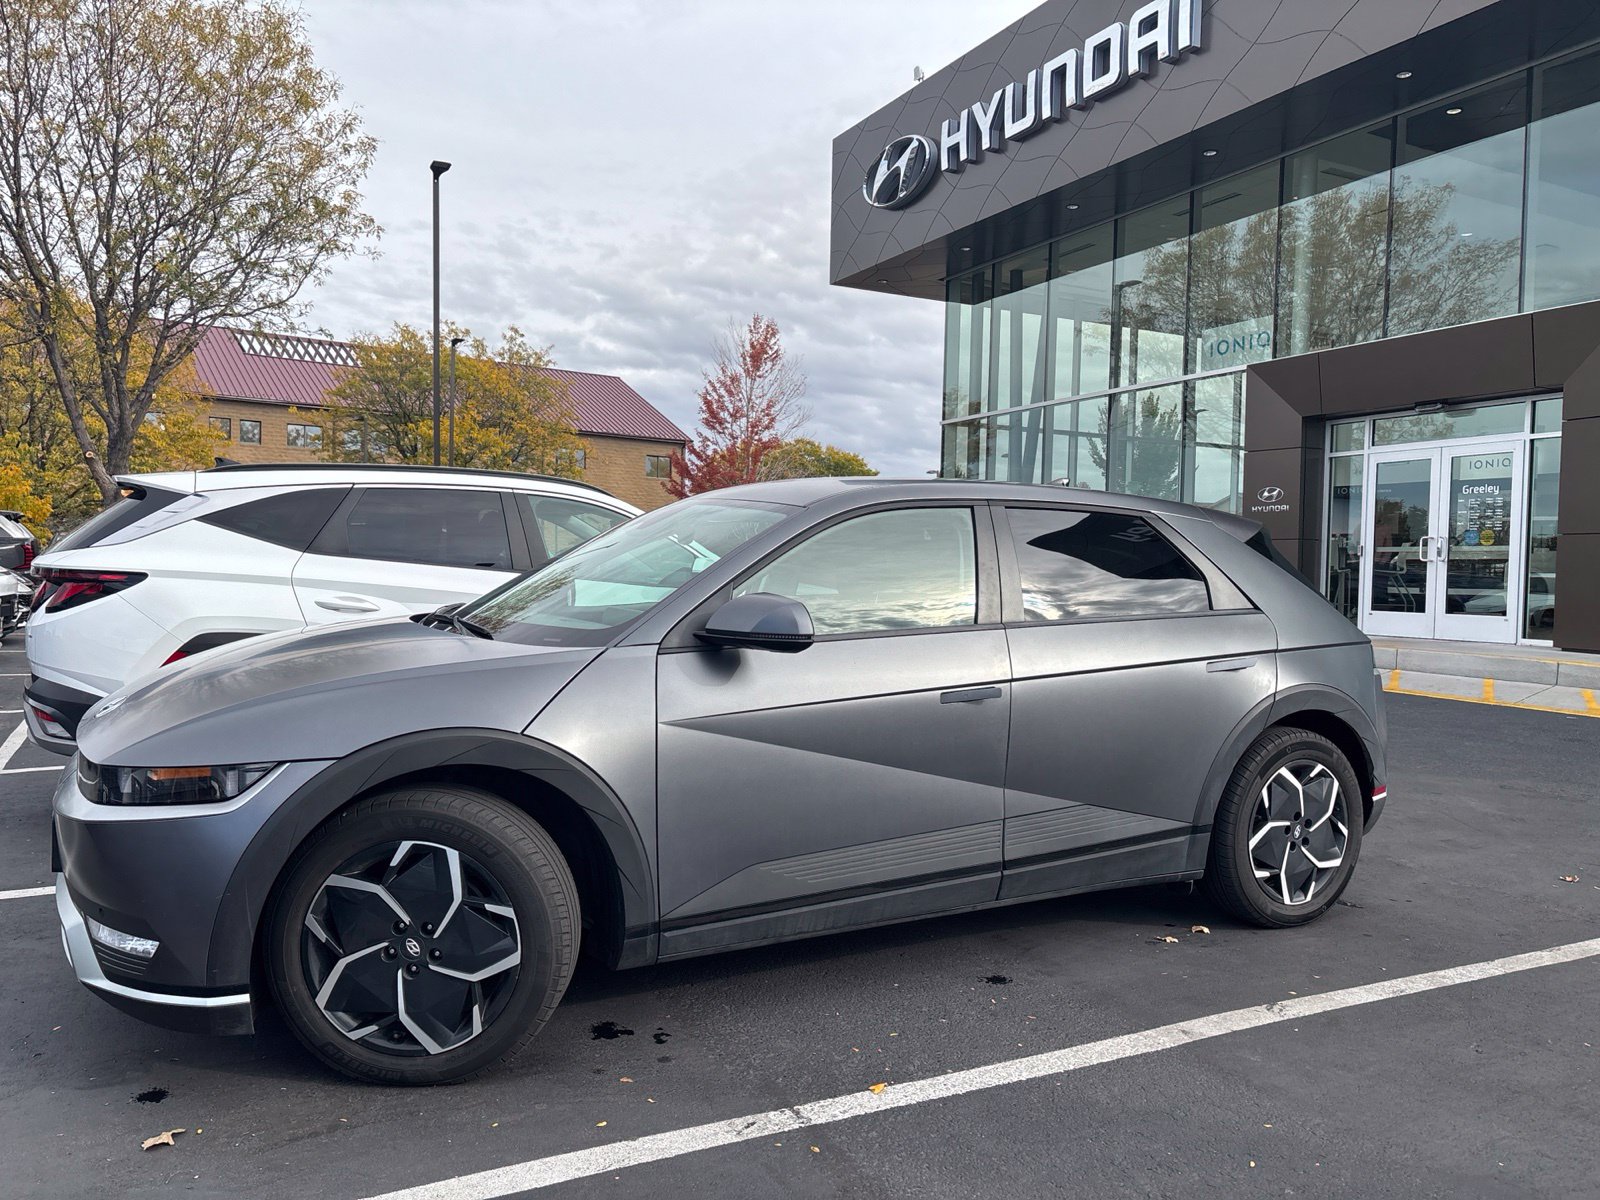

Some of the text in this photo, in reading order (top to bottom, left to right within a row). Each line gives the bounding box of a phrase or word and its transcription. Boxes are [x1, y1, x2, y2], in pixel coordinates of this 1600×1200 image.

[940, 0, 1195, 172] HYUNDAI
[1209, 331, 1271, 358] IONIQ
[1469, 457, 1512, 470] IONIQ
[1337, 487, 1362, 495] IONI
[1462, 484, 1500, 495] Greeley
[1251, 504, 1290, 513] HYUNDAI
[419, 817, 498, 856] MICHELIN
